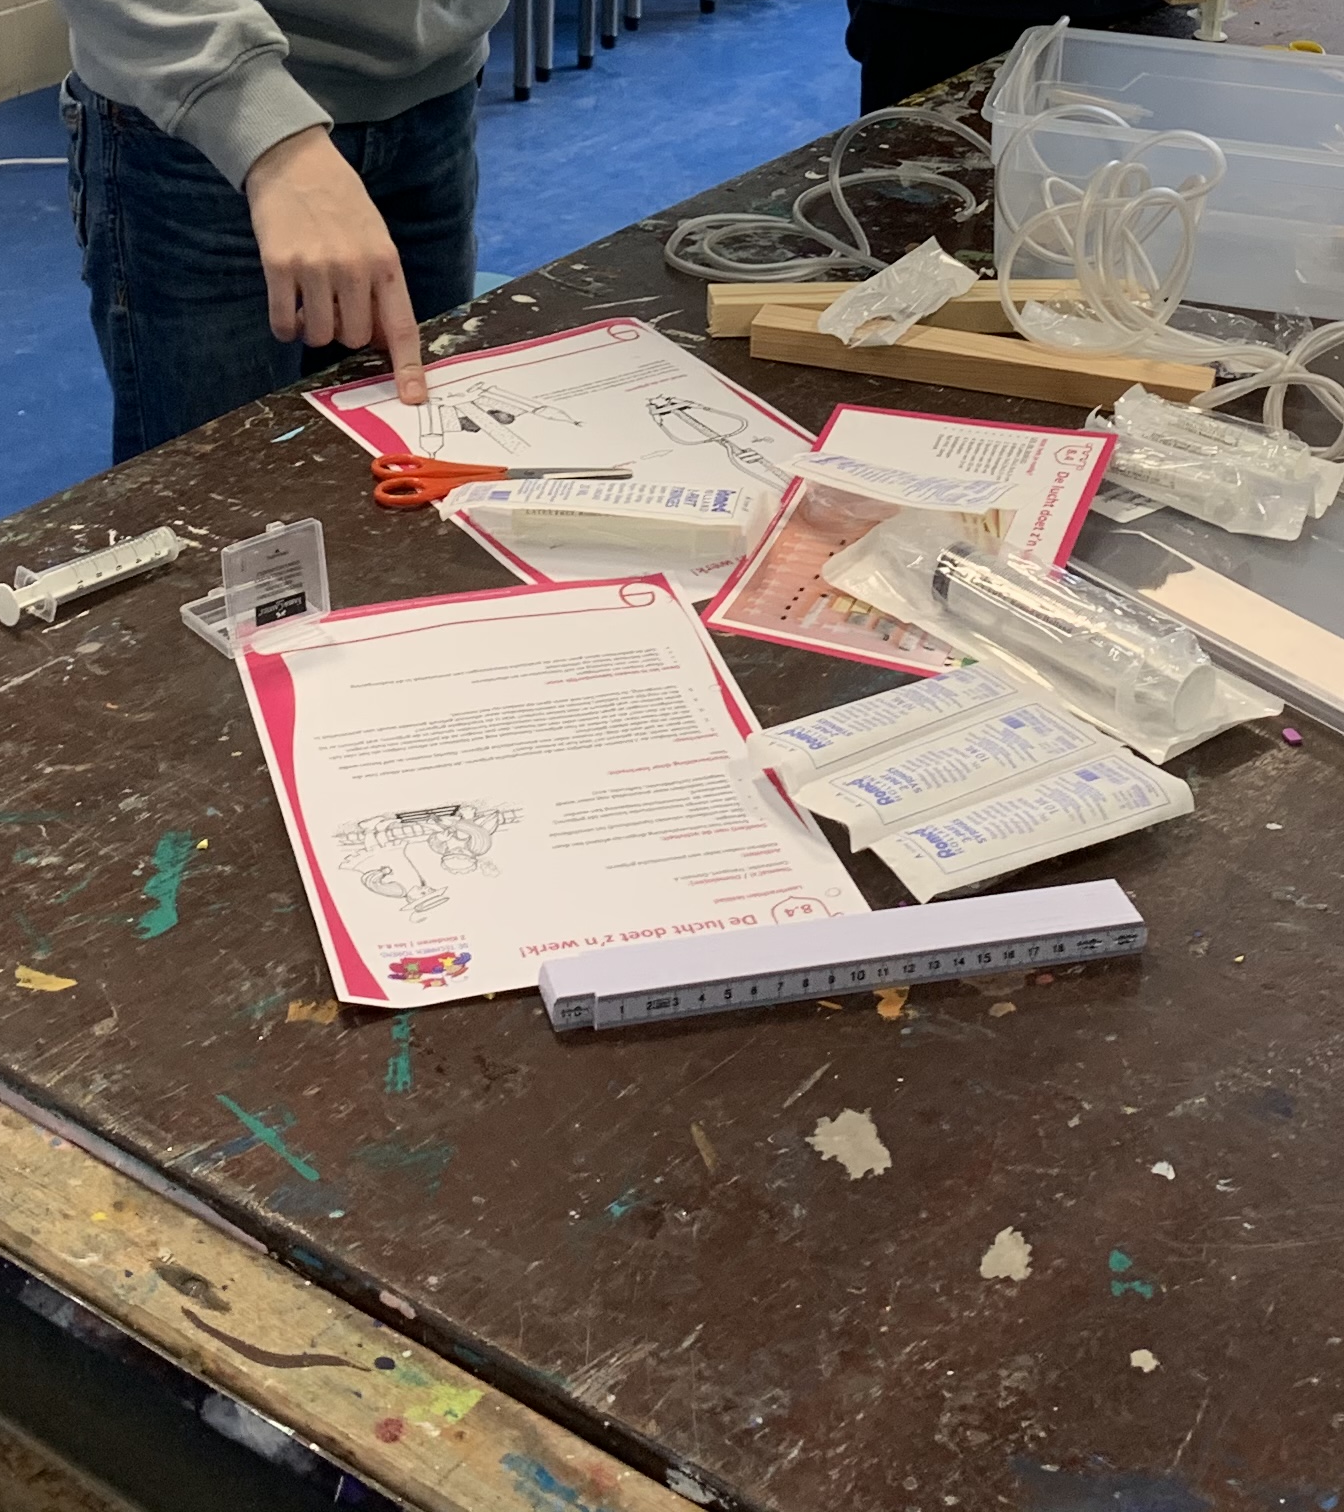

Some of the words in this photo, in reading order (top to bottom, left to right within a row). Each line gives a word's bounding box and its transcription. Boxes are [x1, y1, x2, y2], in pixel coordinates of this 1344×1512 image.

[1054, 471, 1070, 484] De
[1042, 484, 1065, 508] lucht
[1033, 508, 1053, 531] doet
[842, 777, 896, 806] Romed
[905, 827, 957, 859] Romed
[784, 903, 813, 918] 8.4
[673, 919, 726, 936] lucht
[729, 913, 758, 927] De
[585, 933, 615, 948] z'n
[619, 926, 668, 941] doet
[519, 939, 580, 959] werk!
[850, 969, 865, 982] 10
[903, 963, 916, 974] 12
[928, 959, 941, 970] 13
[953, 956, 965, 967] 14
[977, 952, 991, 964] 15
[1003, 949, 1015, 961] 16
[1028, 946, 1040, 958] 17
